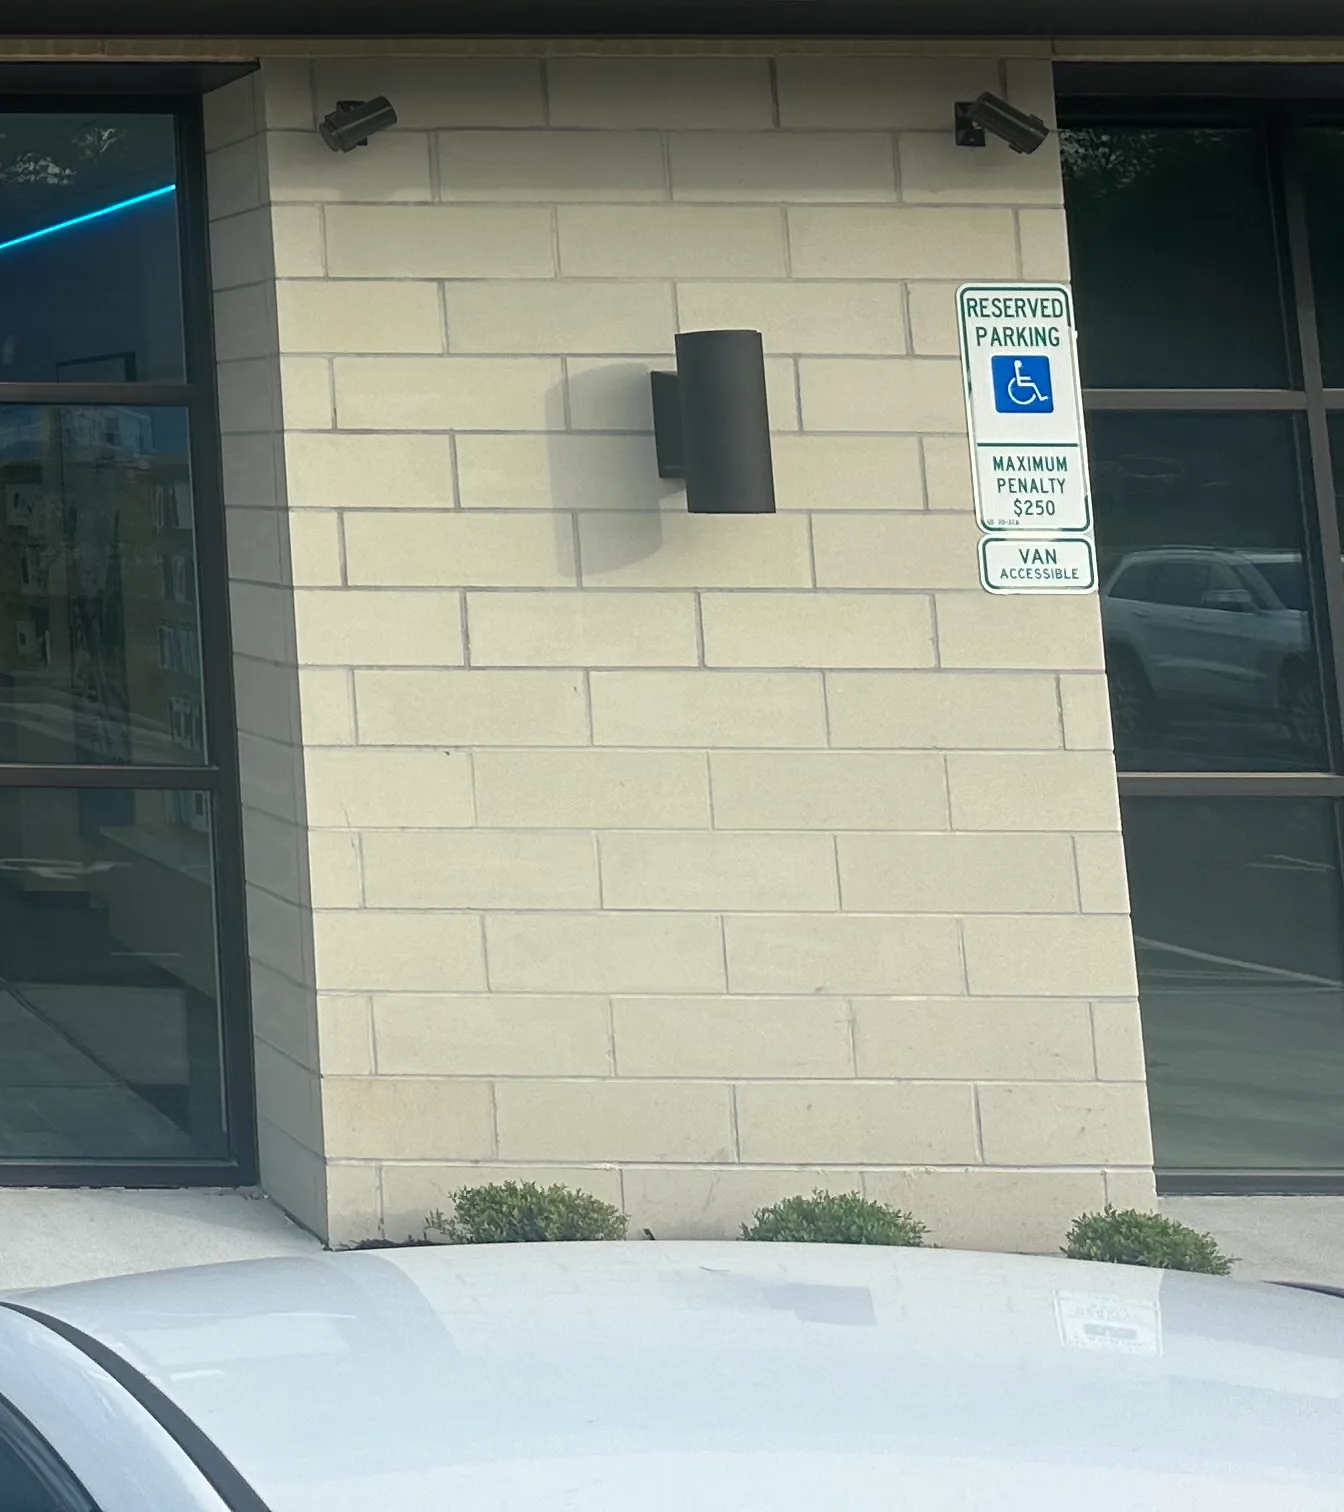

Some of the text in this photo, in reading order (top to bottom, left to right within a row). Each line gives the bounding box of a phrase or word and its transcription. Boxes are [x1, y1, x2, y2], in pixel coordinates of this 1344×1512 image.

[966, 297, 1064, 319] RESERVED
[975, 326, 1060, 348] PARKING
[992, 455, 1068, 472] MAXIMUM
[996, 477, 1066, 494] PENALTY
[1013, 497, 1056, 518] $250
[1018, 548, 1057, 565] VAN
[999, 567, 1080, 580] ACCESSIBLE
